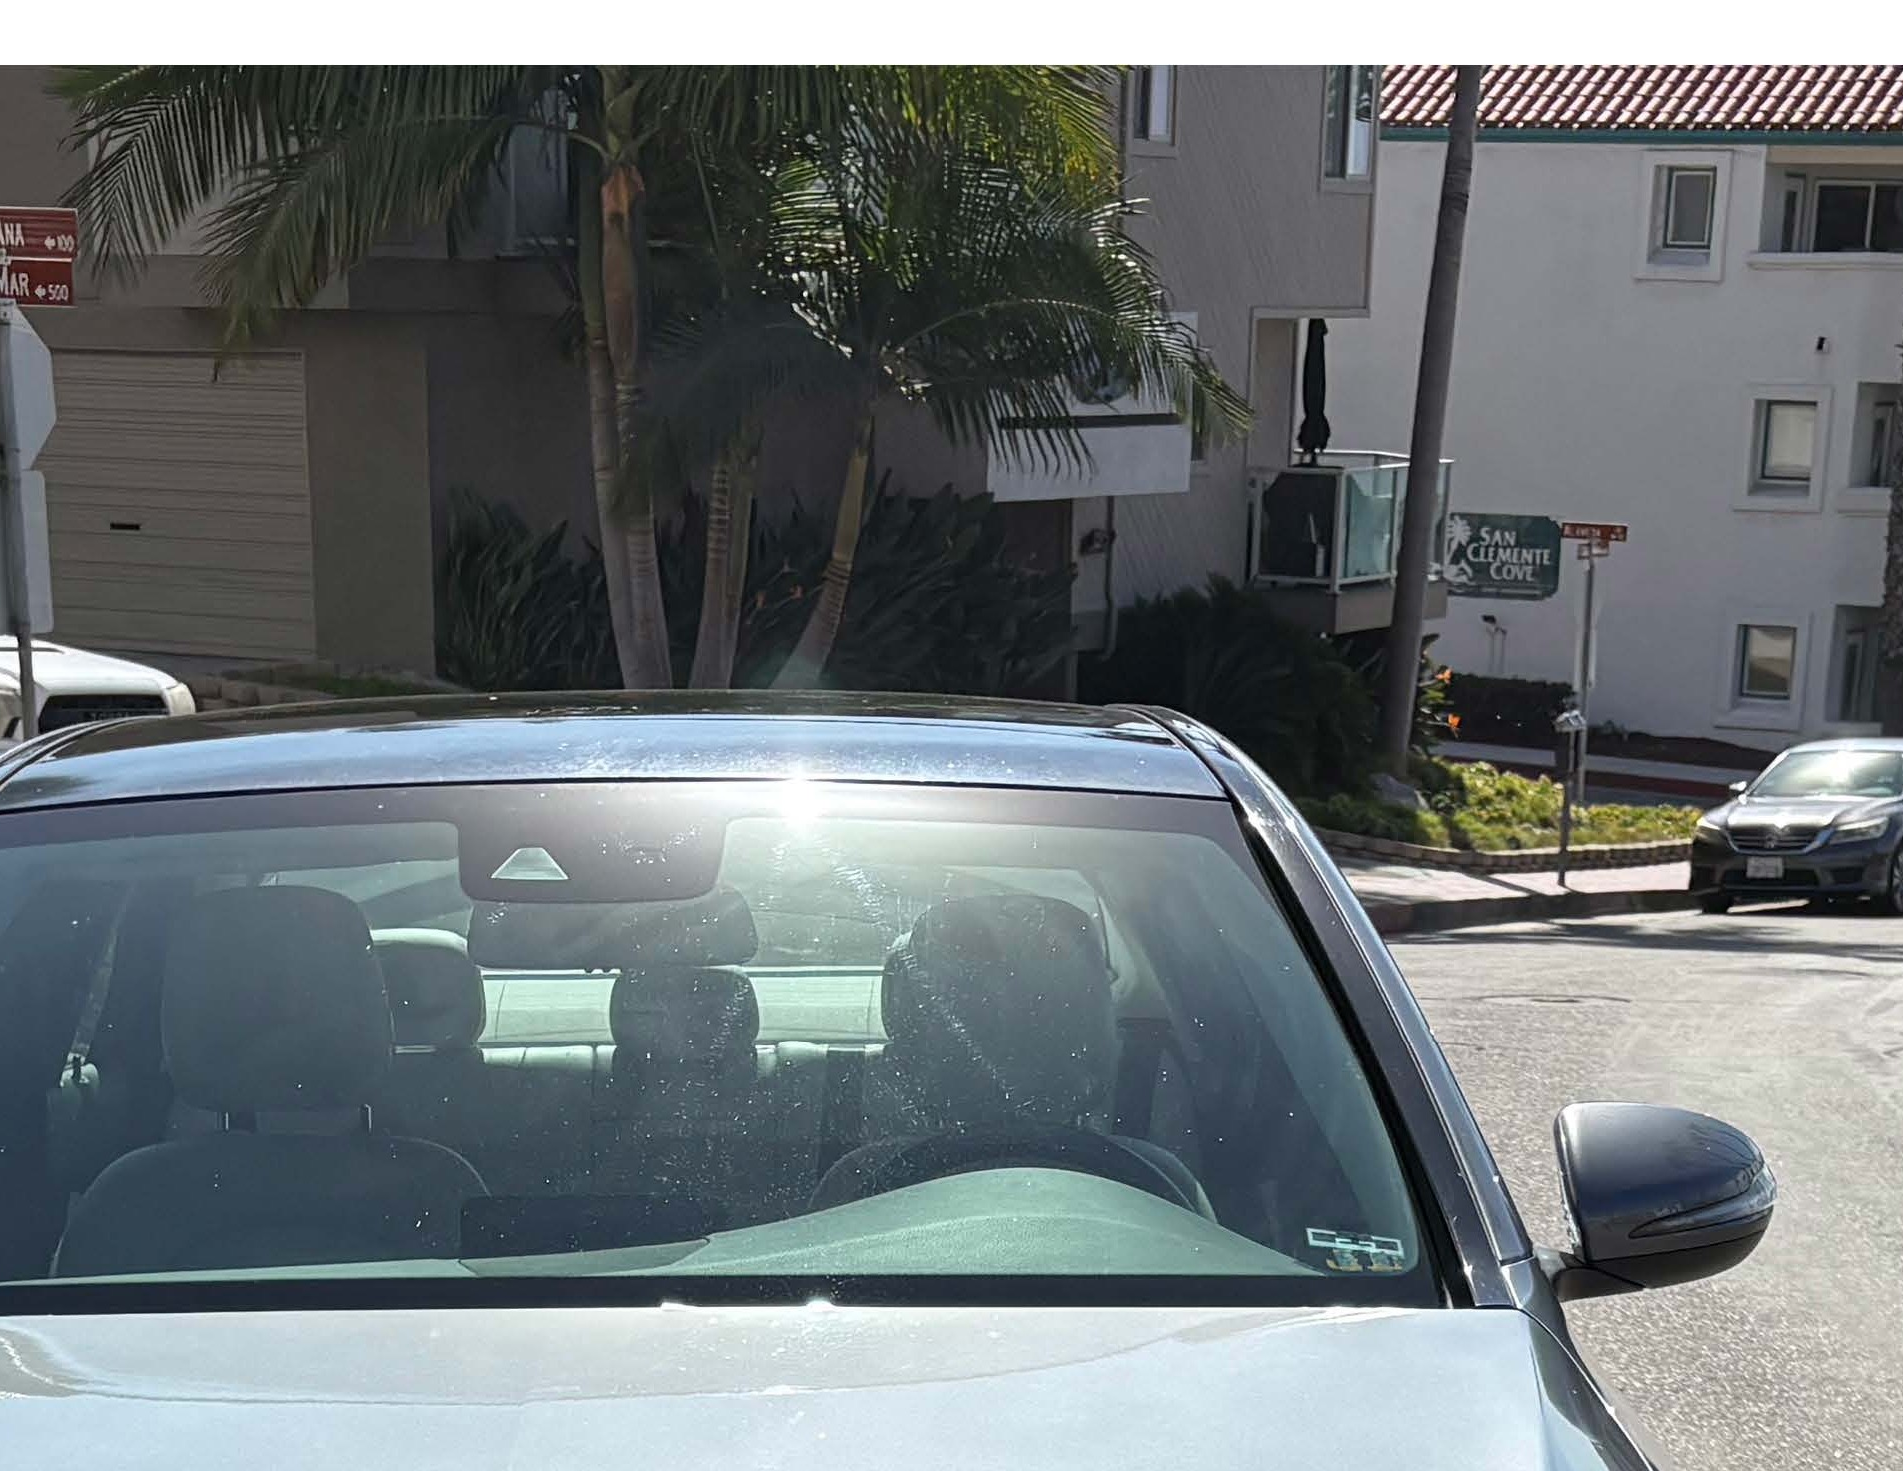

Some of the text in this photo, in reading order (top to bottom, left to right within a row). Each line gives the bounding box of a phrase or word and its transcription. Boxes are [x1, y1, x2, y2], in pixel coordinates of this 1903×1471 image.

[1479, 526, 1517, 547] SAN
[1466, 543, 1551, 566] CLEMENTE
[1489, 562, 1535, 581] COVE
